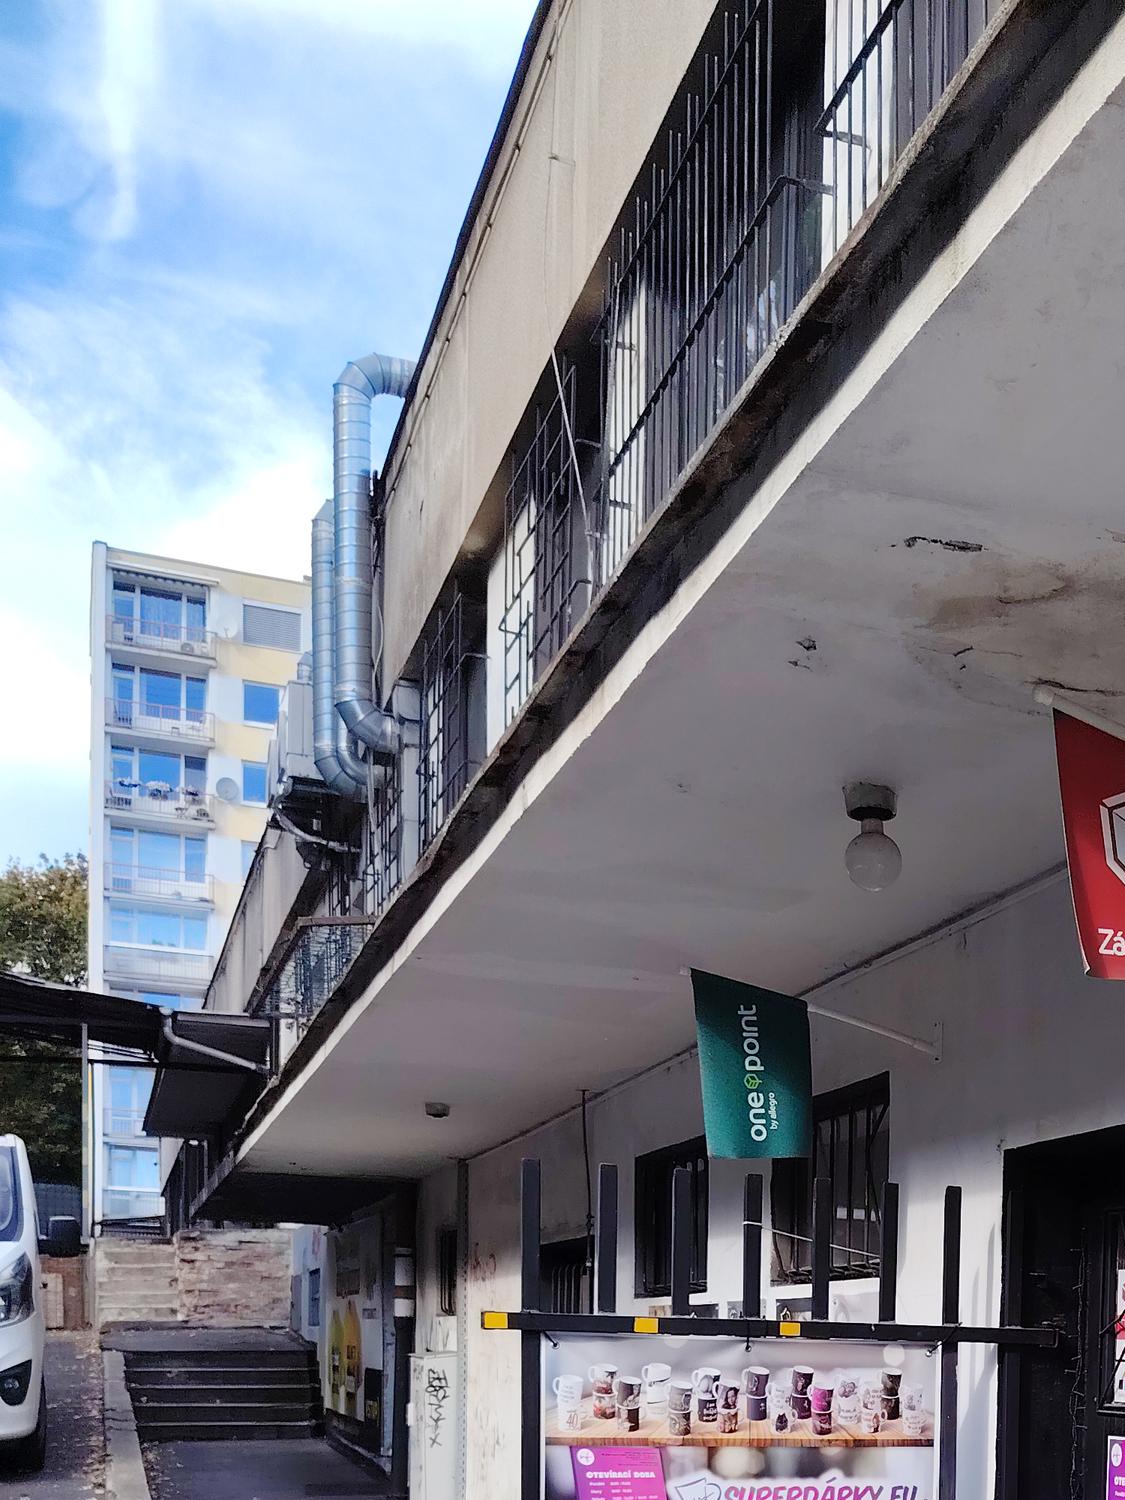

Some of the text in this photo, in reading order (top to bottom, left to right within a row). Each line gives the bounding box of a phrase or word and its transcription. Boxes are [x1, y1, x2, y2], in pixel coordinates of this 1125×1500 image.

[738, 1004, 768, 1142] one point
[768, 1091, 778, 1119] allegro
